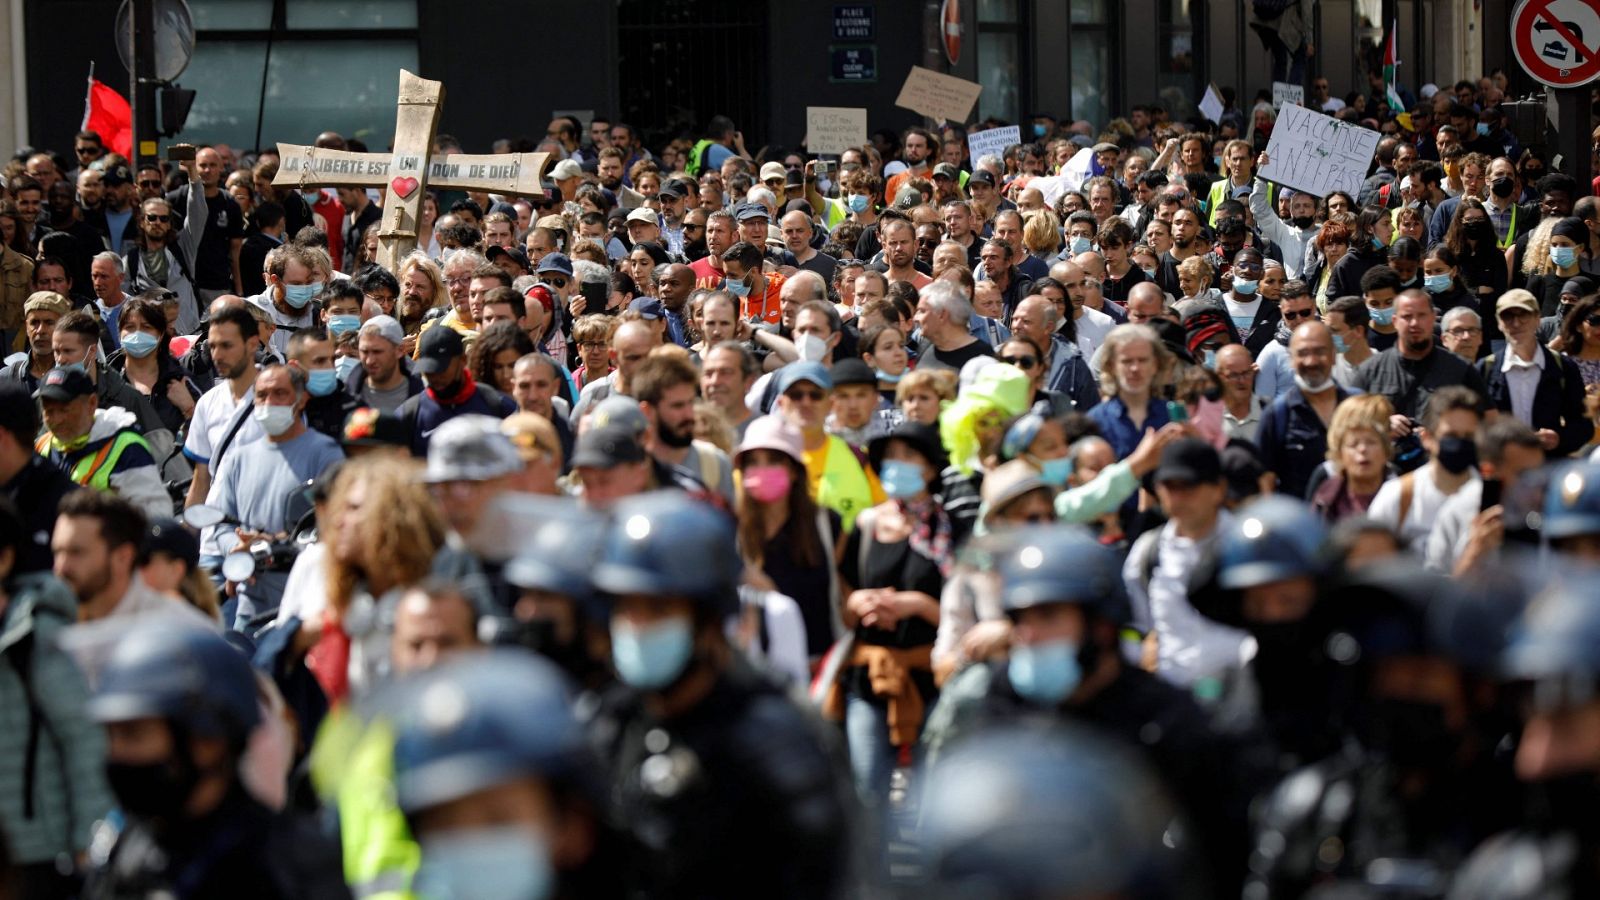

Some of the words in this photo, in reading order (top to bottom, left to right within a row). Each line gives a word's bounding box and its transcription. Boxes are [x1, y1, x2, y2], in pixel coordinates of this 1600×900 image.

[969, 134, 981, 143] BIG
[982, 127, 1018, 139] BROTHER
[283, 156, 298, 172] LA
[314, 156, 364, 174] LIBERTÉ
[367, 161, 390, 176] EST
[399, 157, 418, 171] UN
[432, 163, 459, 178] DON
[469, 164, 486, 178] DE
[489, 164, 519, 179] DIEU
